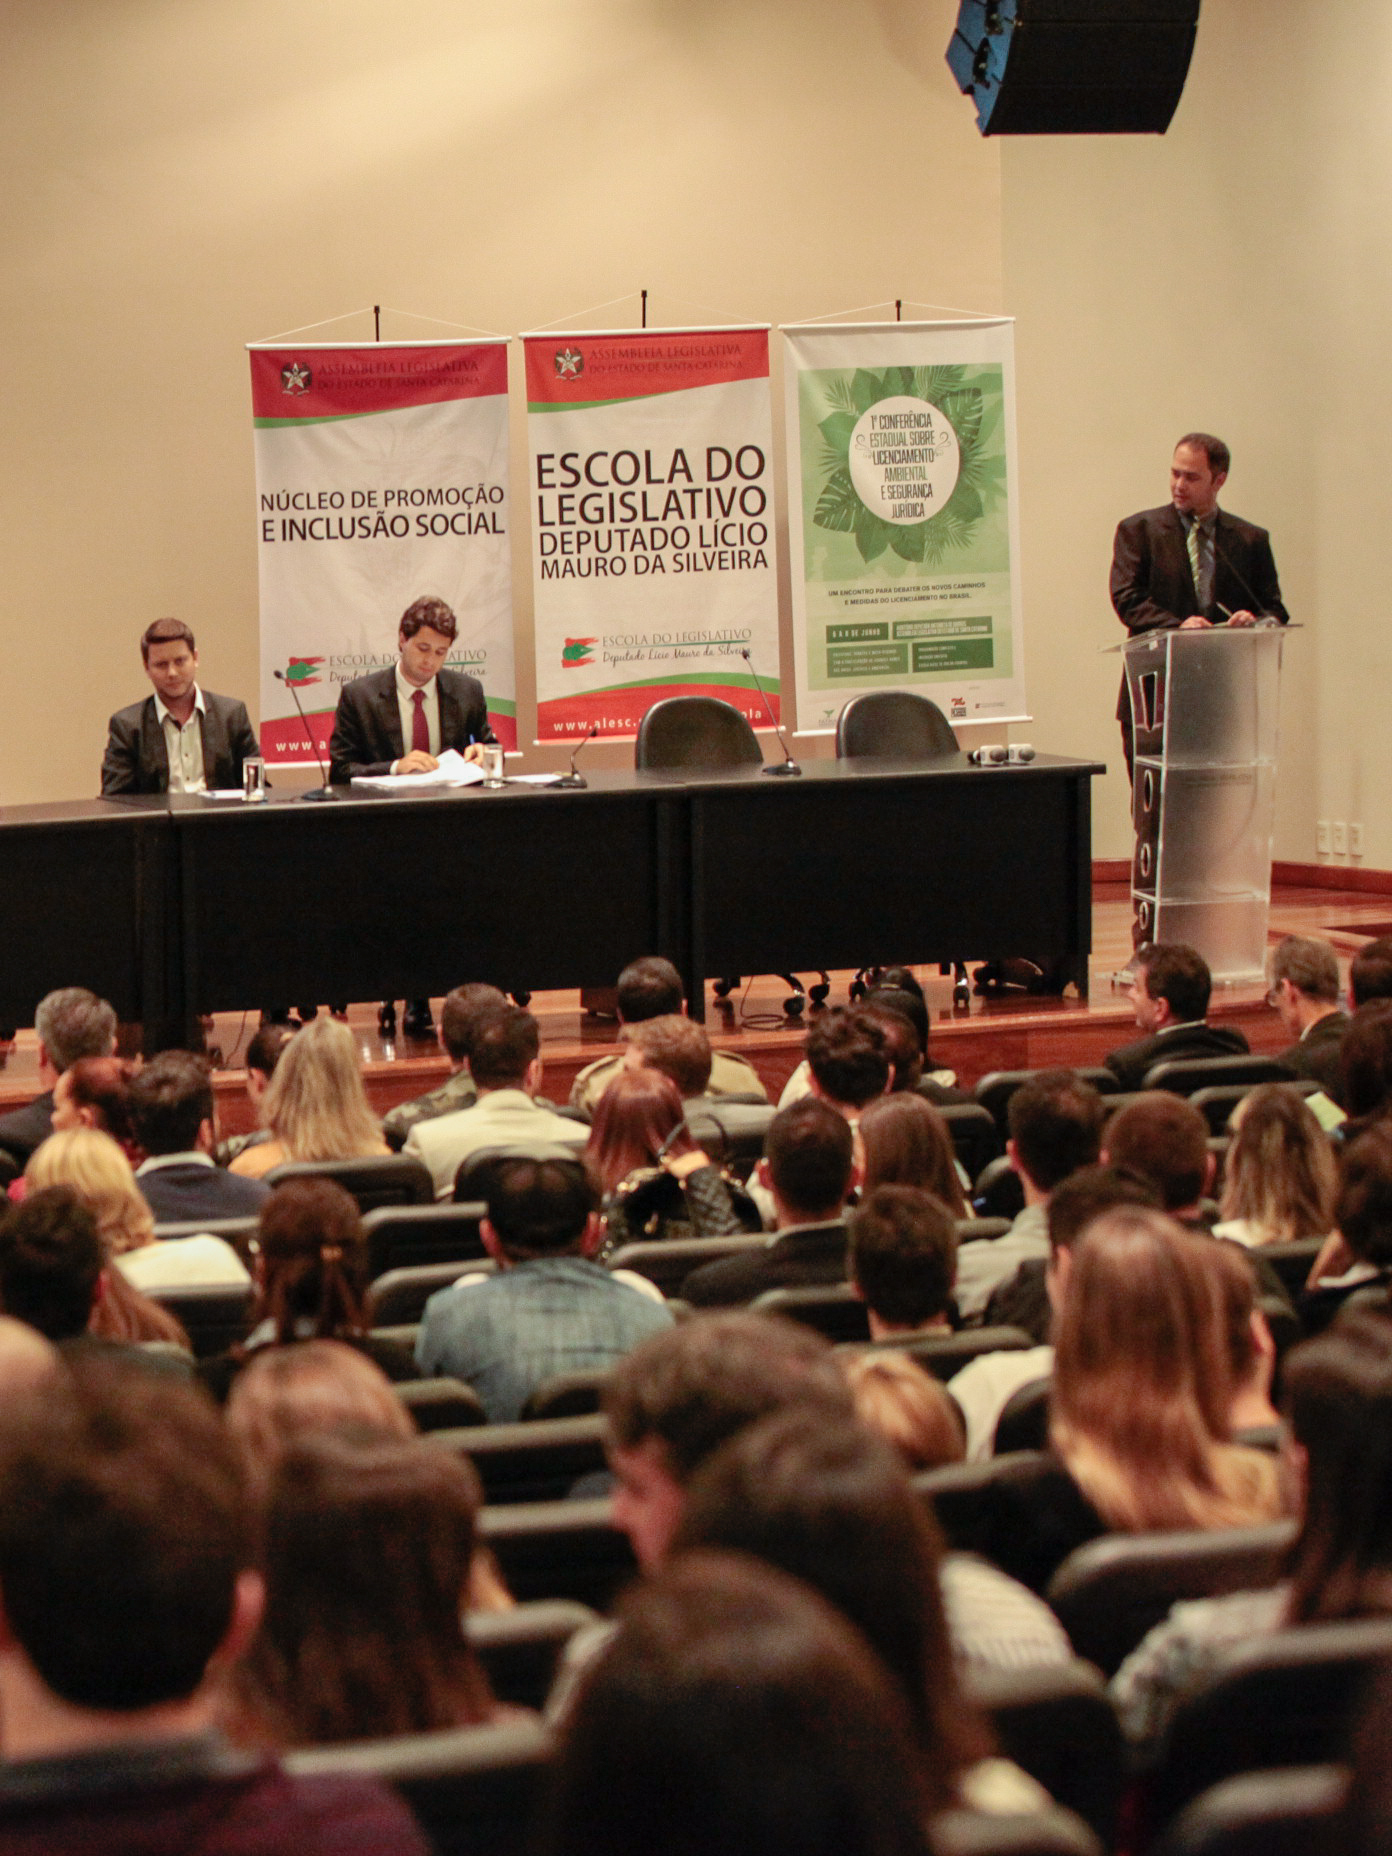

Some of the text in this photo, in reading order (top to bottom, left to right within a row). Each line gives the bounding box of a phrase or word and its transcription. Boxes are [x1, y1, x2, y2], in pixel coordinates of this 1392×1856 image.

[668, 345, 741, 356] LEGISLATIVA
[880, 410, 932, 429] CONFERÊNCIA
[870, 431, 935, 448] ESTADUAL SOBRE
[873, 448, 934, 465] LICENCIAMENTO
[537, 445, 765, 488] ESCOLA DO
[885, 466, 927, 482] AMBIENTAL
[261, 484, 504, 511] NÚCLEO DE PROMOÇÃO
[881, 483, 933, 501] E SEGURANÇA
[539, 485, 766, 526] LEGISLATIVO
[892, 501, 924, 518] JURÍDICA
[263, 510, 505, 542] E INCLUSÃO SOCIAL
[540, 519, 767, 556] DEPUTADO LÍCIO
[541, 549, 768, 579] MAURO DA SILVEIRA
[891, 595, 938, 603] LICENCIAMENTO
[603, 629, 752, 646] ESCOLA DO LEGISLATIVO
[330, 655, 377, 666] ESCOLA
[603, 649, 645, 667] Deputado
[674, 648, 700, 659] Mauro
[703, 646, 714, 656] da
[554, 717, 641, 731] www.alesc.
